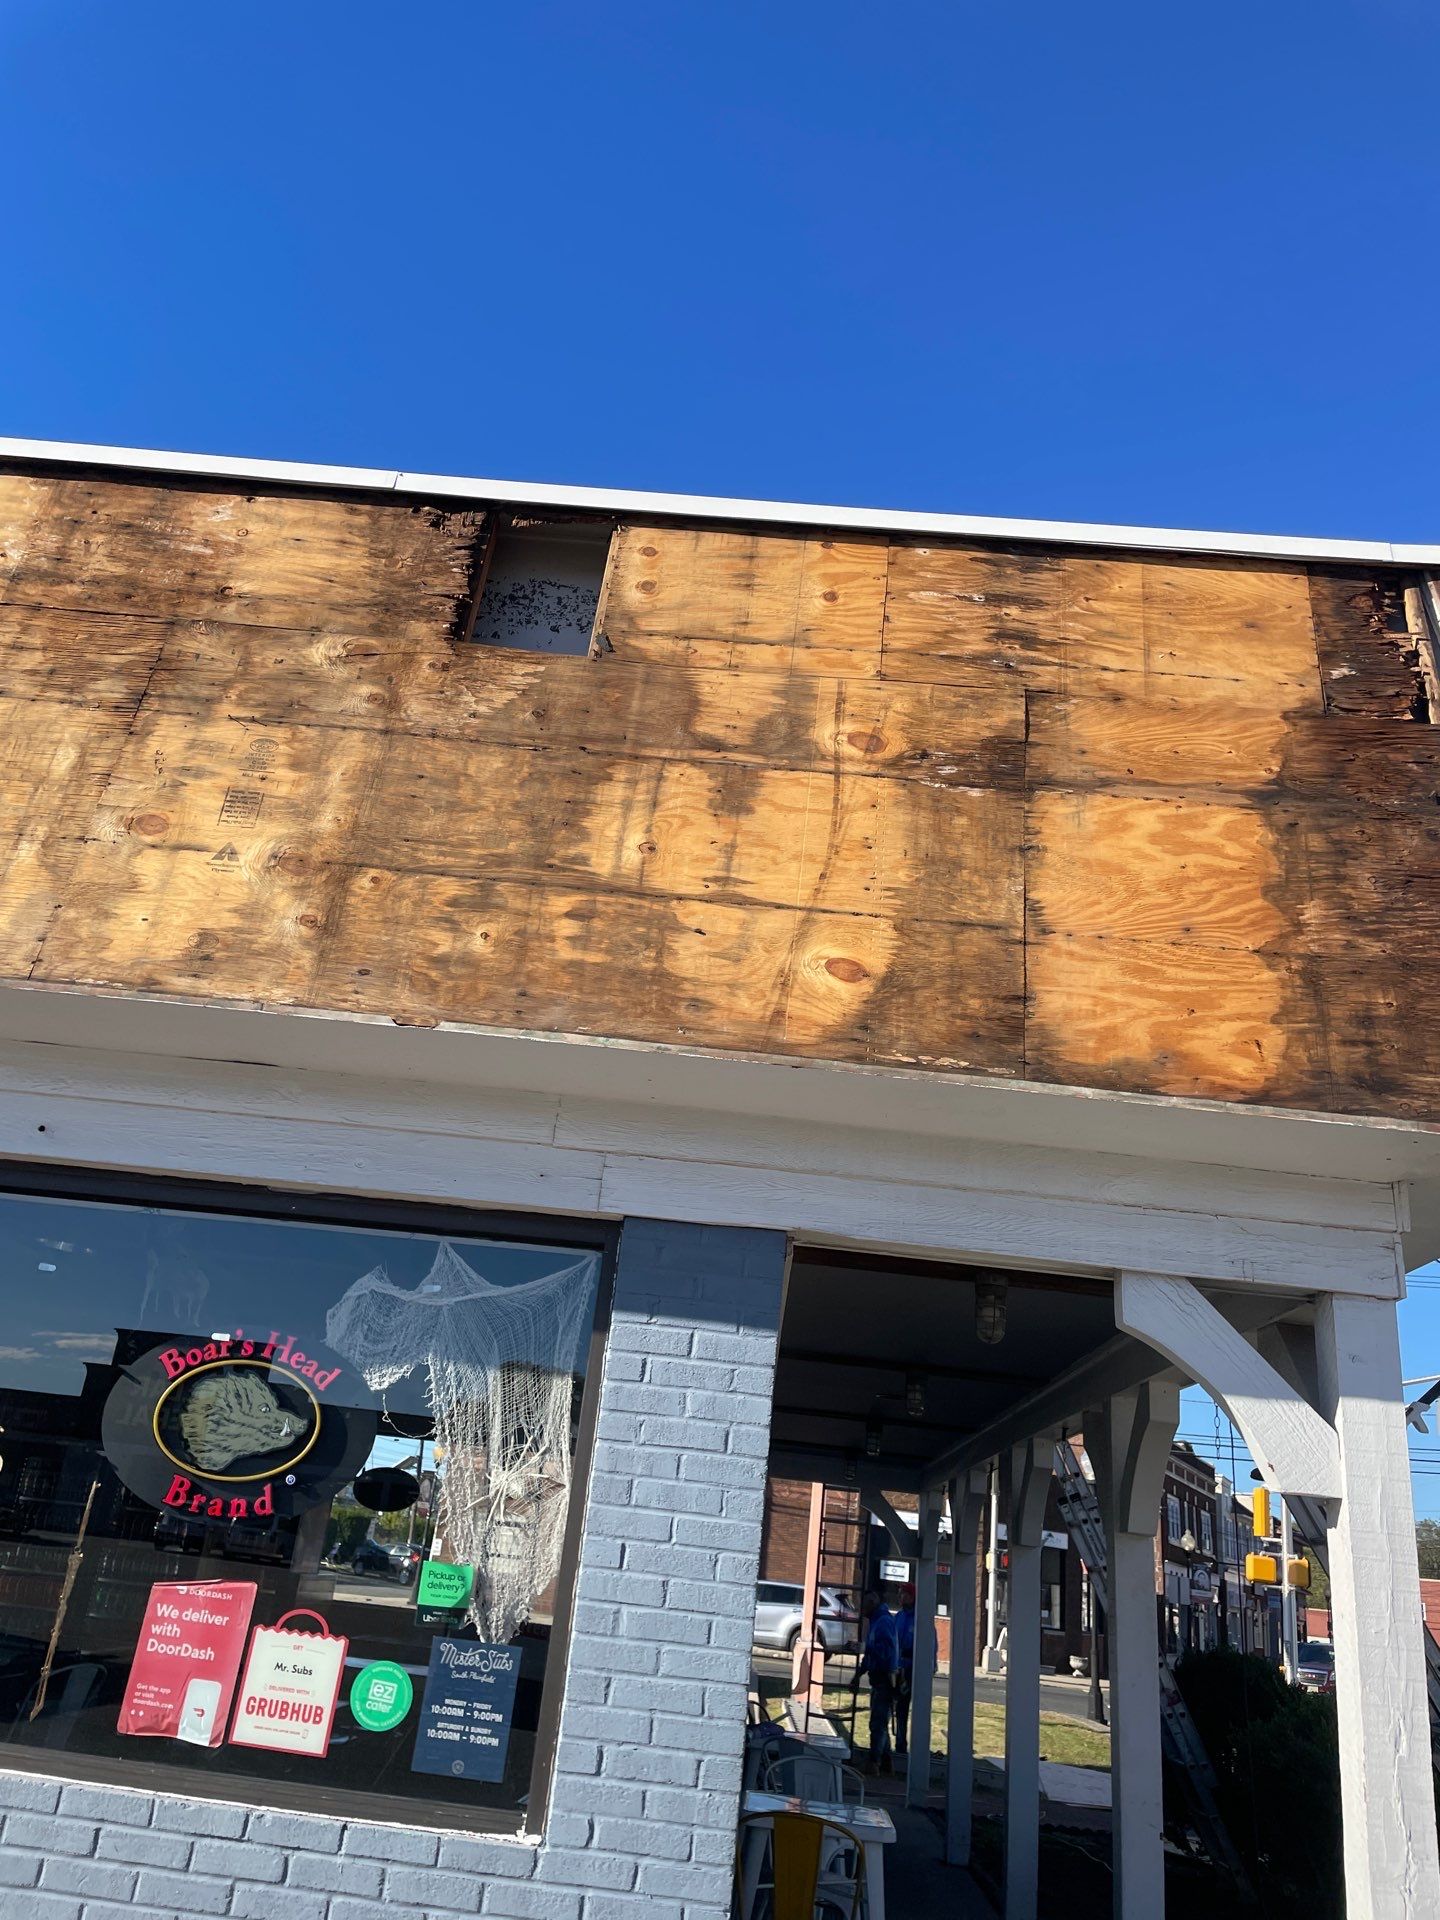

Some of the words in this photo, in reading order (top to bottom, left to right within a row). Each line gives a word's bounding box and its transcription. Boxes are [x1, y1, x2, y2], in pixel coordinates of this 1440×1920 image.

[158, 1328, 254, 1380] Boar's
[260, 1331, 342, 1391] Head
[162, 1474, 274, 1518] Brand
[428, 1570, 456, 1582] Pickup
[189, 1588, 233, 1600] DOORDASH
[427, 1581, 466, 1593] delivery?
[157, 1603, 180, 1619] We
[182, 1608, 230, 1626] deliver
[151, 1622, 181, 1638] with
[146, 1638, 215, 1661] DoorDash
[440, 1642, 485, 1668] Mister
[480, 1649, 514, 1672] Subs
[273, 1662, 290, 1672] Mr.
[291, 1664, 314, 1676] Subs
[136, 1682, 148, 1690] Get
[373, 1684, 394, 1700] ez
[245, 1696, 324, 1725] GRUBHUB
[366, 1700, 392, 1713] cater
[431, 1704, 464, 1718] 10:00AM
[473, 1710, 504, 1723] 9:00PM
[473, 1702, 493, 1711] FRIDAY
[427, 1728, 460, 1742] 10:00AM
[469, 1734, 500, 1747] 9:00PM
